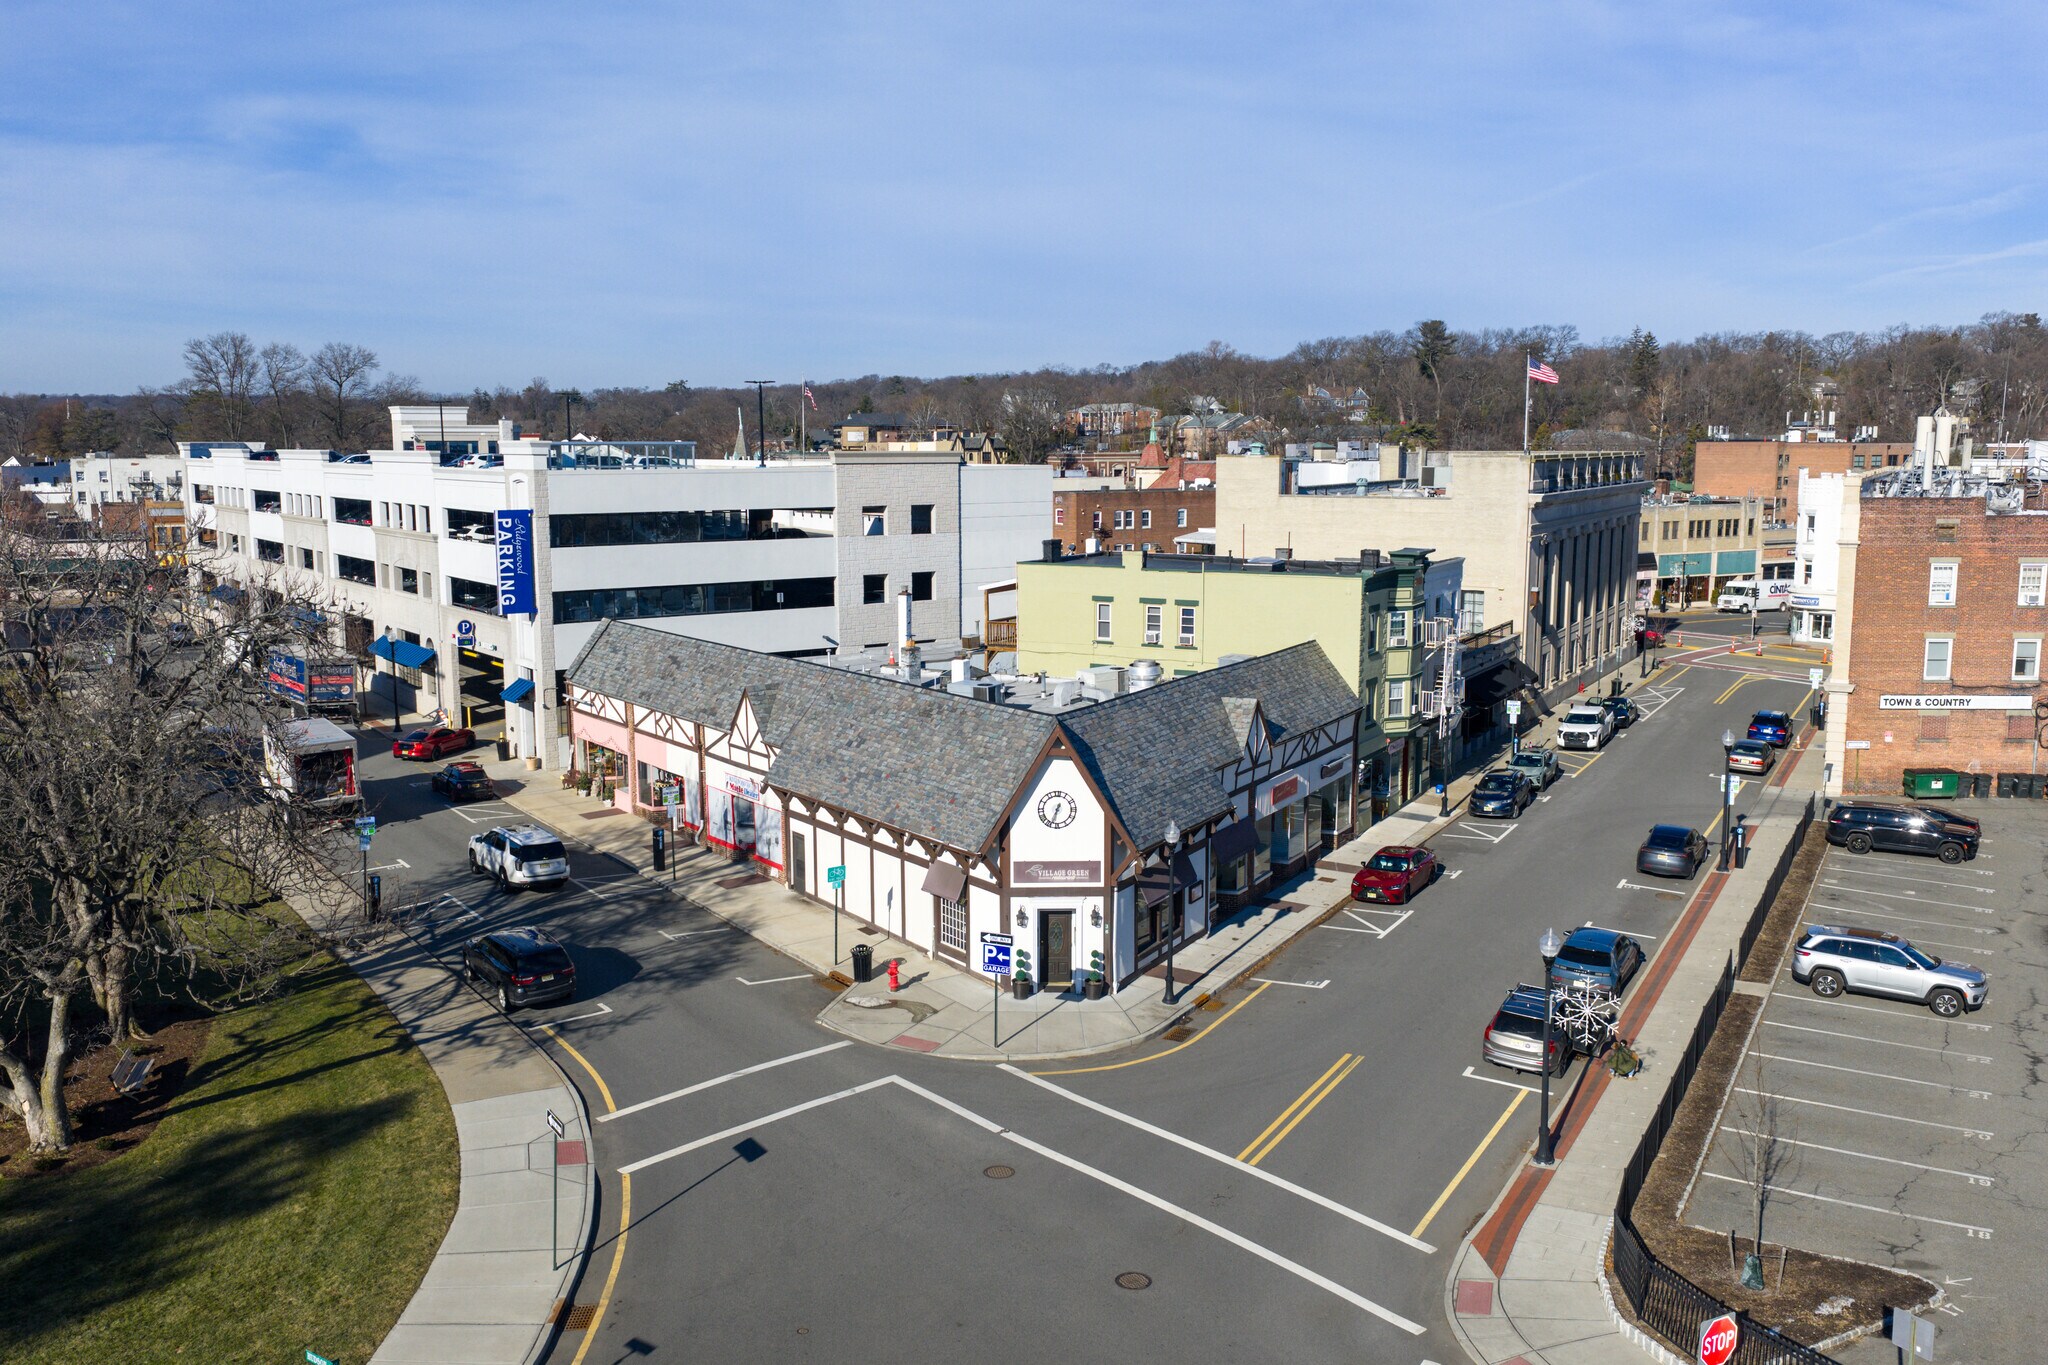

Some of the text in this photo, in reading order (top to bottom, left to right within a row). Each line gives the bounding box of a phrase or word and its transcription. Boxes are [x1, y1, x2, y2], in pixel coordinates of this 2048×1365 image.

[512, 518, 528, 576] Ridgewood
[497, 518, 516, 606] PARKING
[1769, 583, 1792, 594] CINTA
[461, 622, 470, 634] P
[1883, 698, 1972, 707] TOWN & COUNTRY
[1038, 869, 1090, 877] VILLAGE GREEN
[984, 944, 998, 964] P
[983, 964, 1011, 975] GARAGE
[1967, 1177, 1991, 1187] 19
[1967, 1229, 1991, 1240] 18
[1704, 1330, 1735, 1355] STOP
